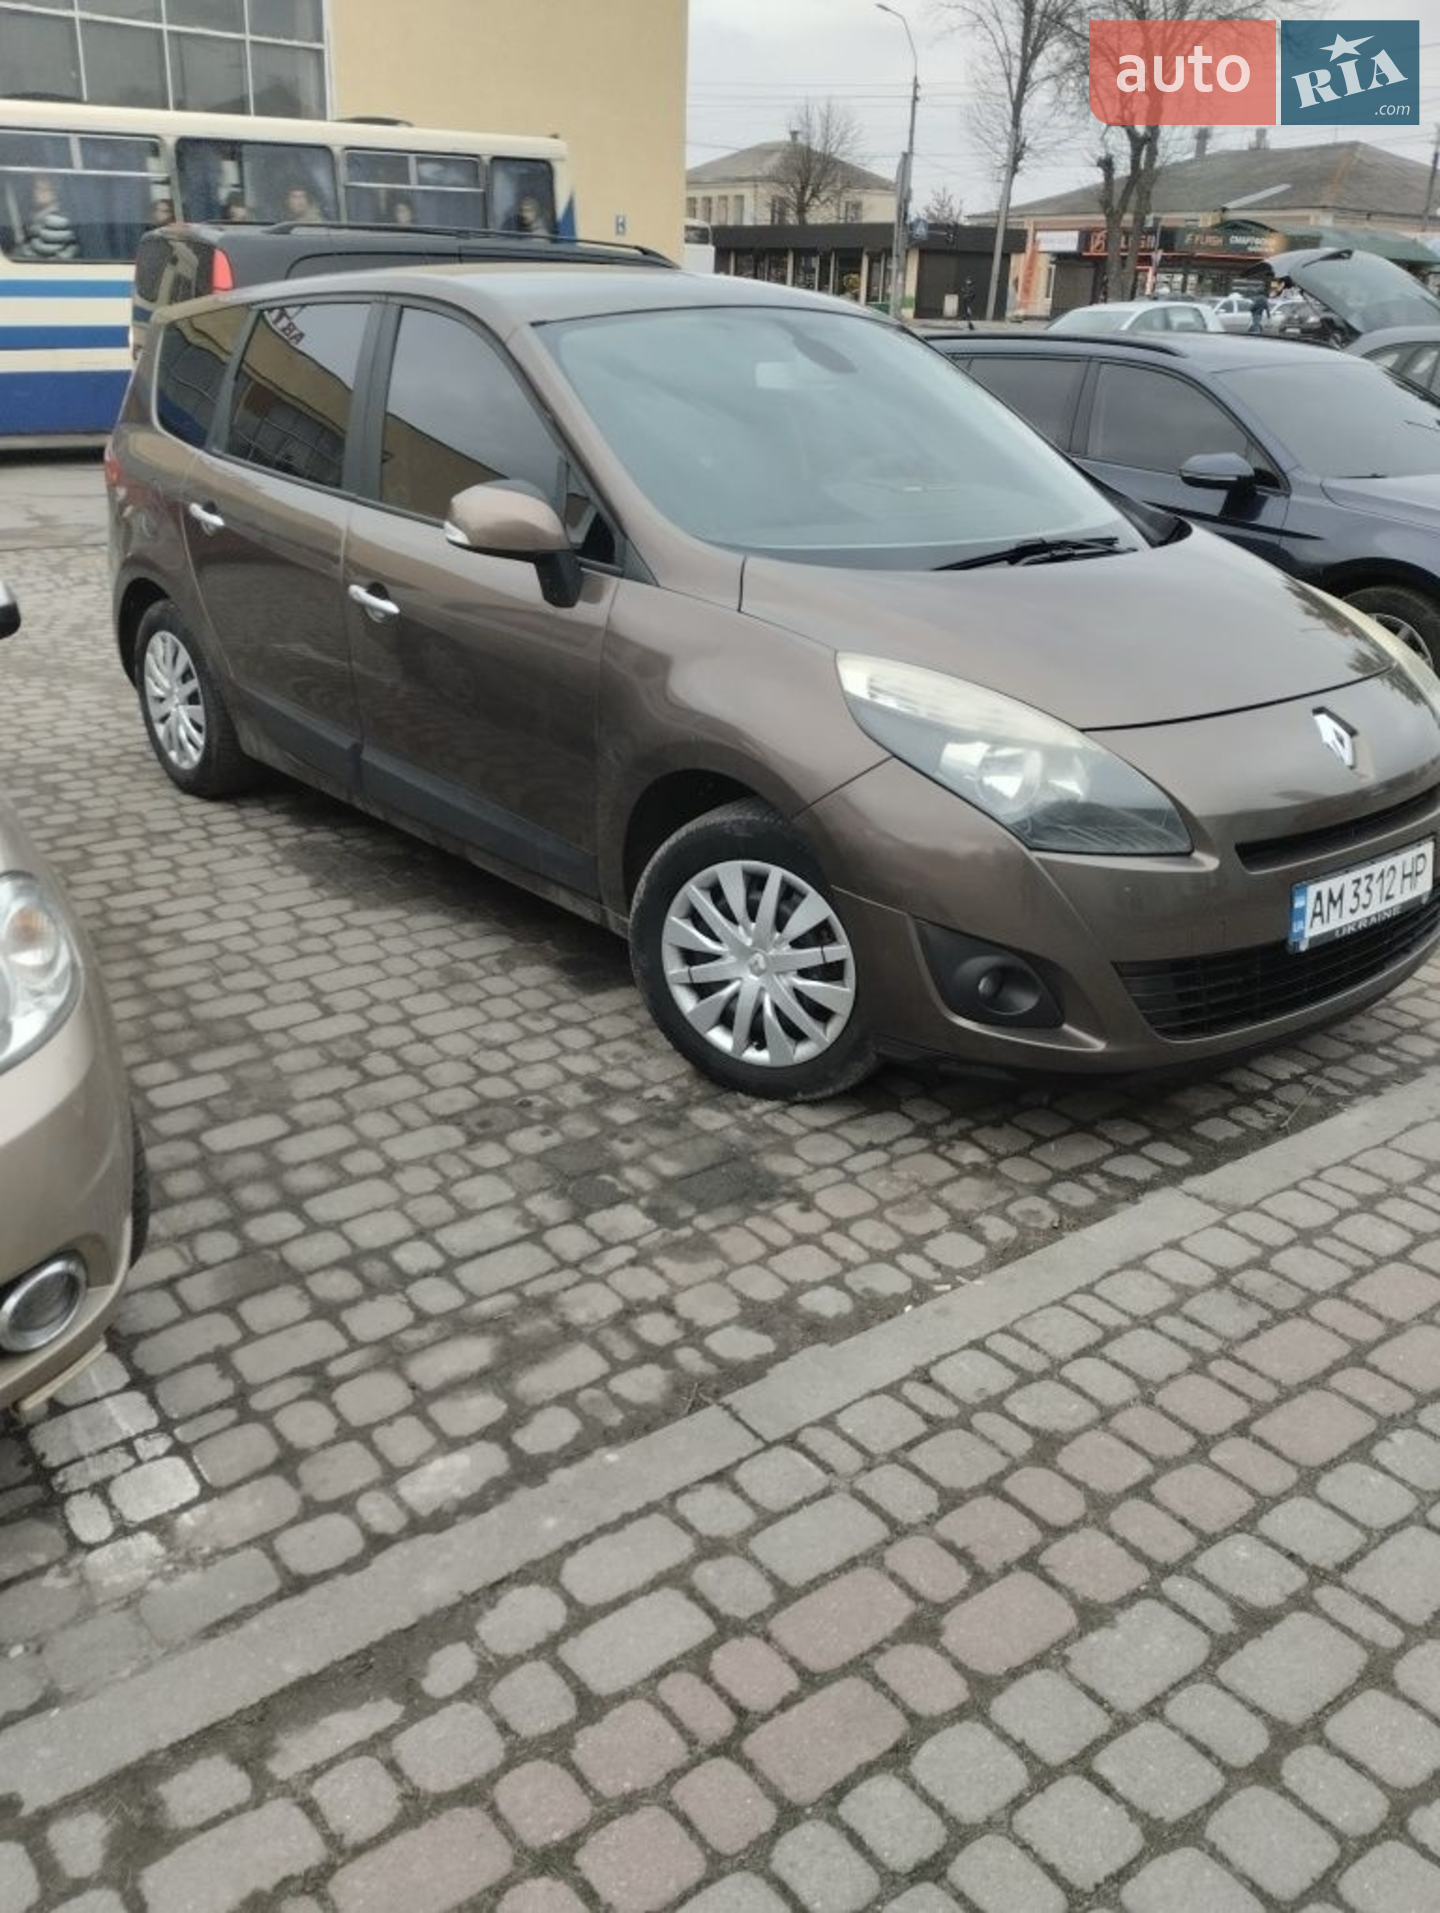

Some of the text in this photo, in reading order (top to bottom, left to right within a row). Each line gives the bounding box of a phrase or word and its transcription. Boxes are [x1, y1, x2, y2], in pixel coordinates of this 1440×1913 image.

[1310, 853, 1427, 929] AM 3312 HP
